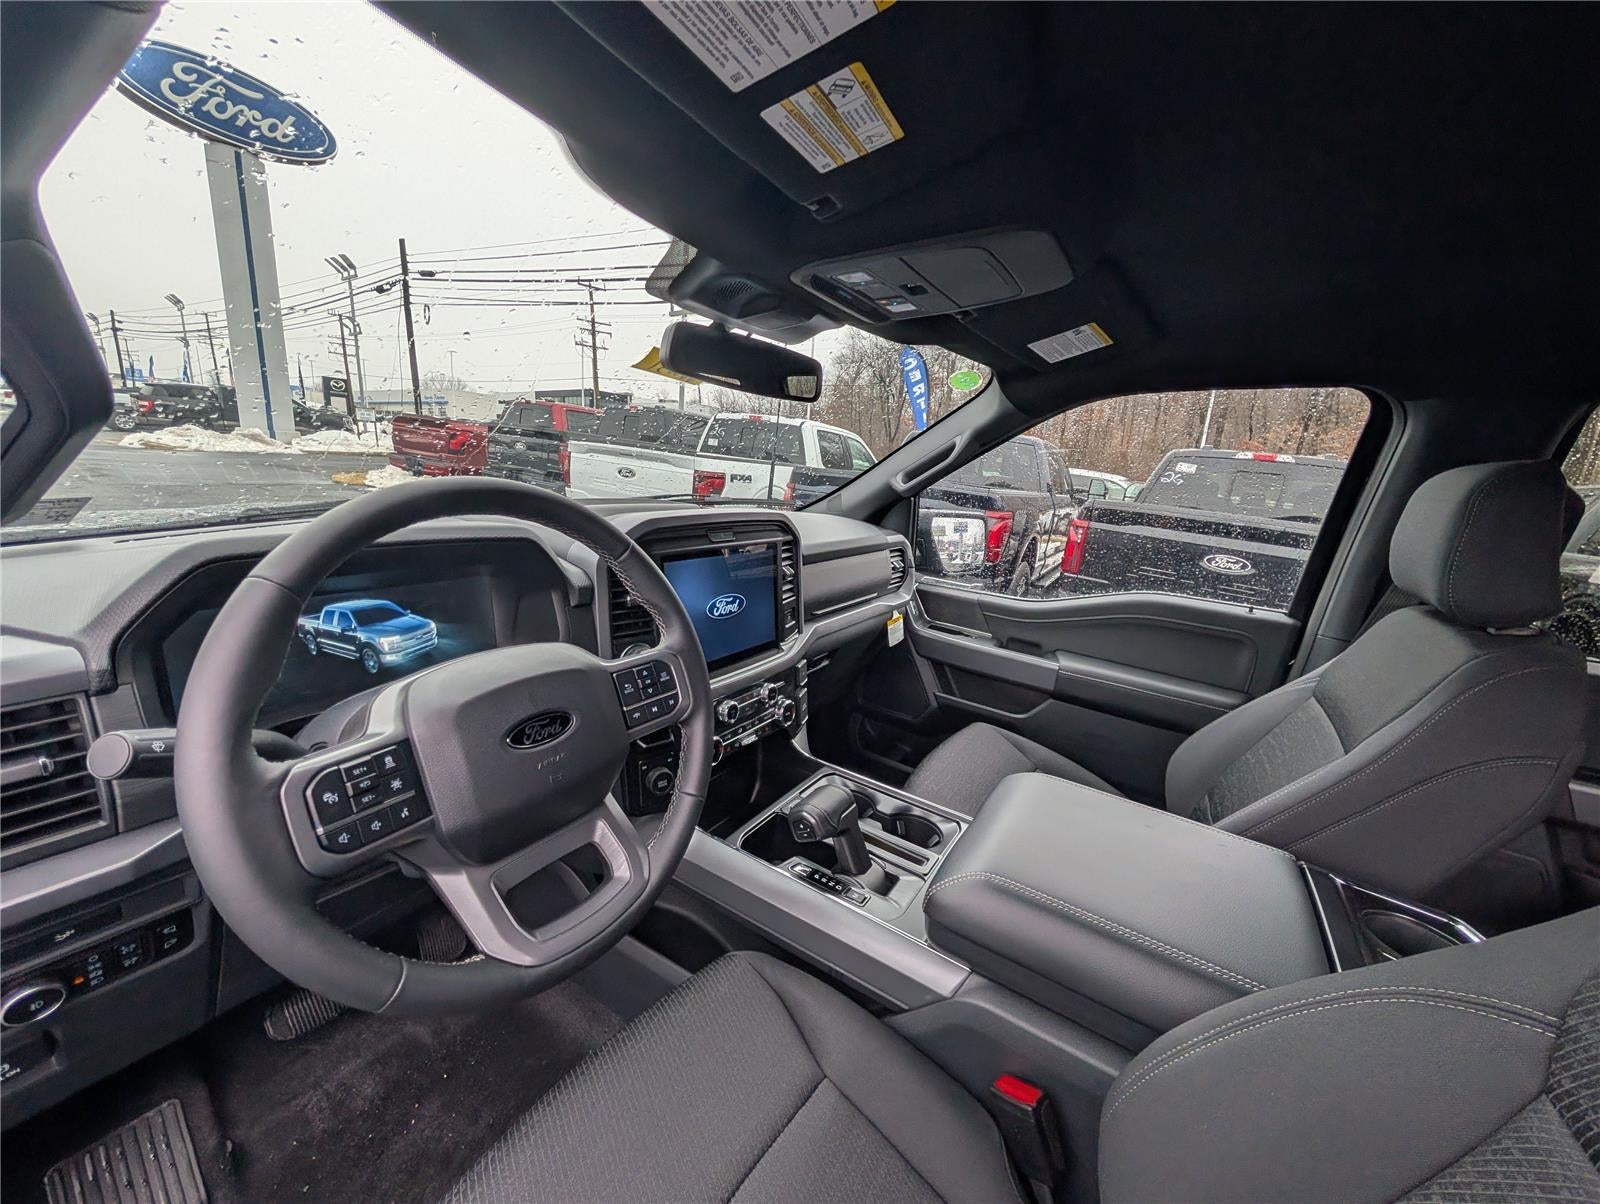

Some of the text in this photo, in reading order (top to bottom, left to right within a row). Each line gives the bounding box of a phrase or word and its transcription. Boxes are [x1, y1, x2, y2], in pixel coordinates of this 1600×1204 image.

[160, 61, 297, 142] Ford
[730, 474, 752, 483] FX4
[1211, 556, 1243, 570] Ford
[713, 597, 740, 616] Ford
[523, 719, 562, 744] Ford
[352, 767, 367, 775] SET+
[361, 795, 376, 803] SET-
